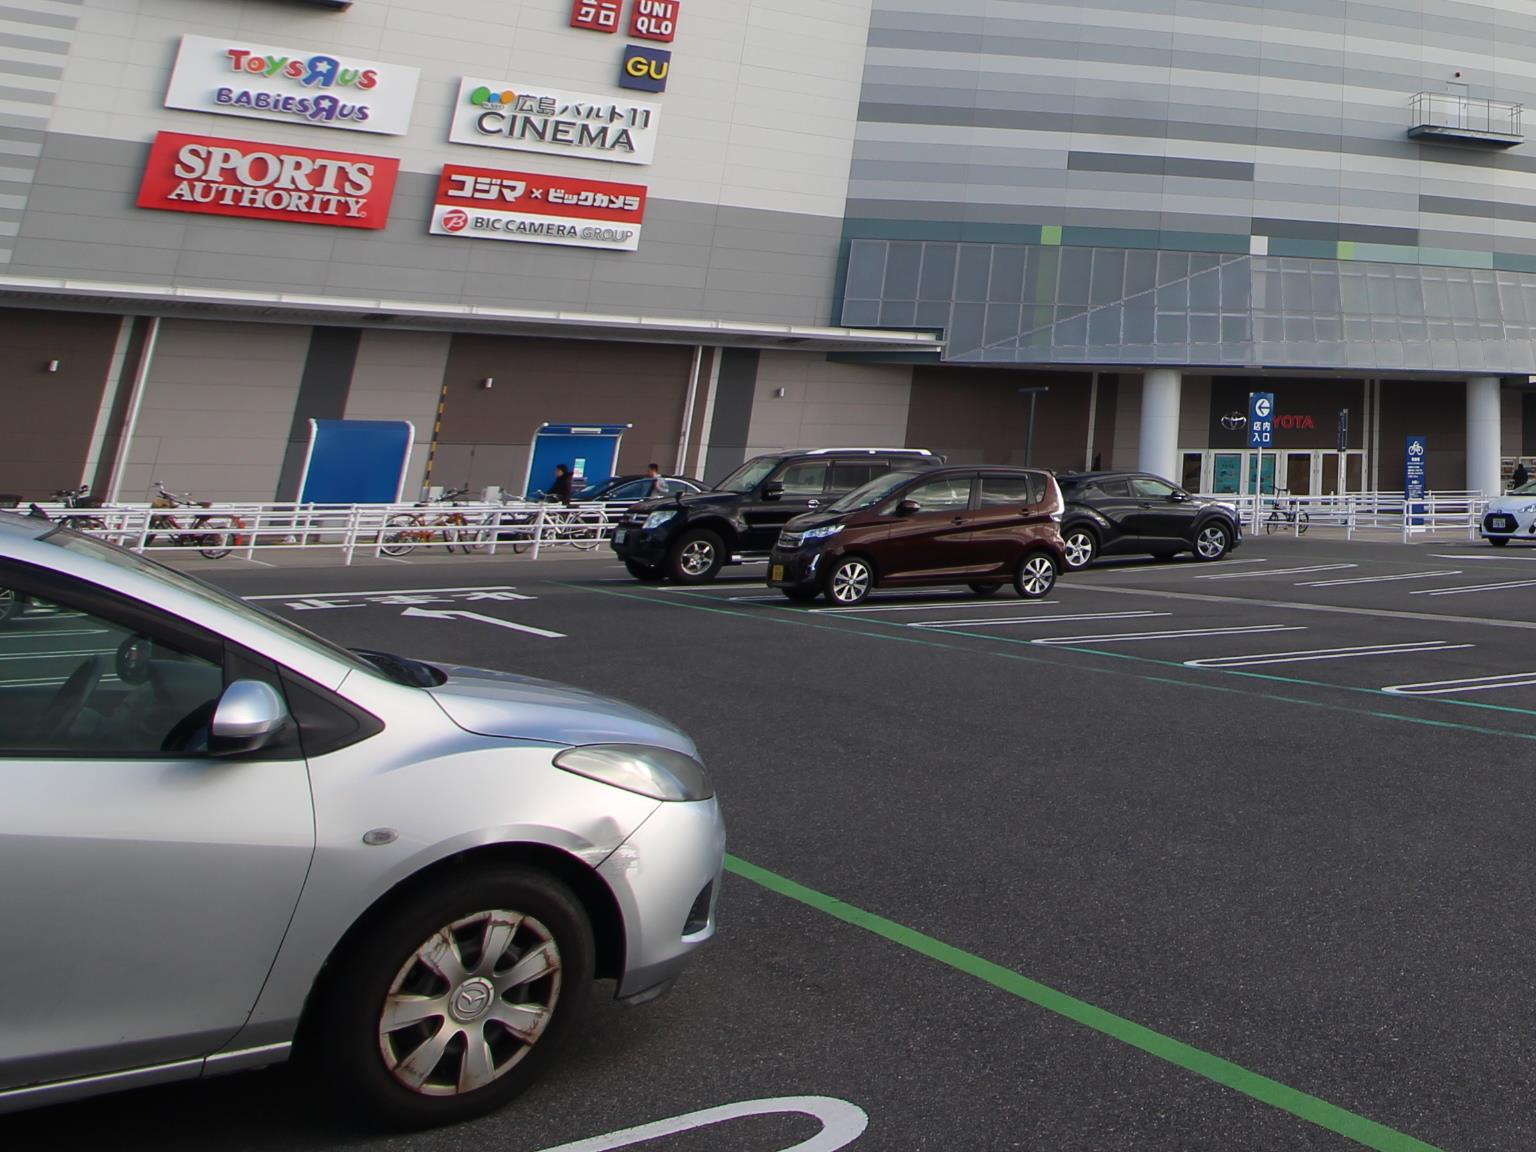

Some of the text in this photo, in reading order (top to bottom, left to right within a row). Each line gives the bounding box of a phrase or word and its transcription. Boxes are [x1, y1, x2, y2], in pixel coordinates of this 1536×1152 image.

[639, 0, 673, 18] UNI
[636, 16, 672, 35] QLO
[626, 56, 668, 80] GU
[476, 110, 636, 153] CINEMA
[174, 143, 375, 196] SPORTS
[167, 180, 367, 218] AUTHORITY
[474, 215, 502, 230] BIC
[505, 219, 578, 237] CAMERA
[581, 227, 633, 241] GROUP
[1273, 415, 1314, 430] YOTA
[1252, 433, 1270, 442] 入口
